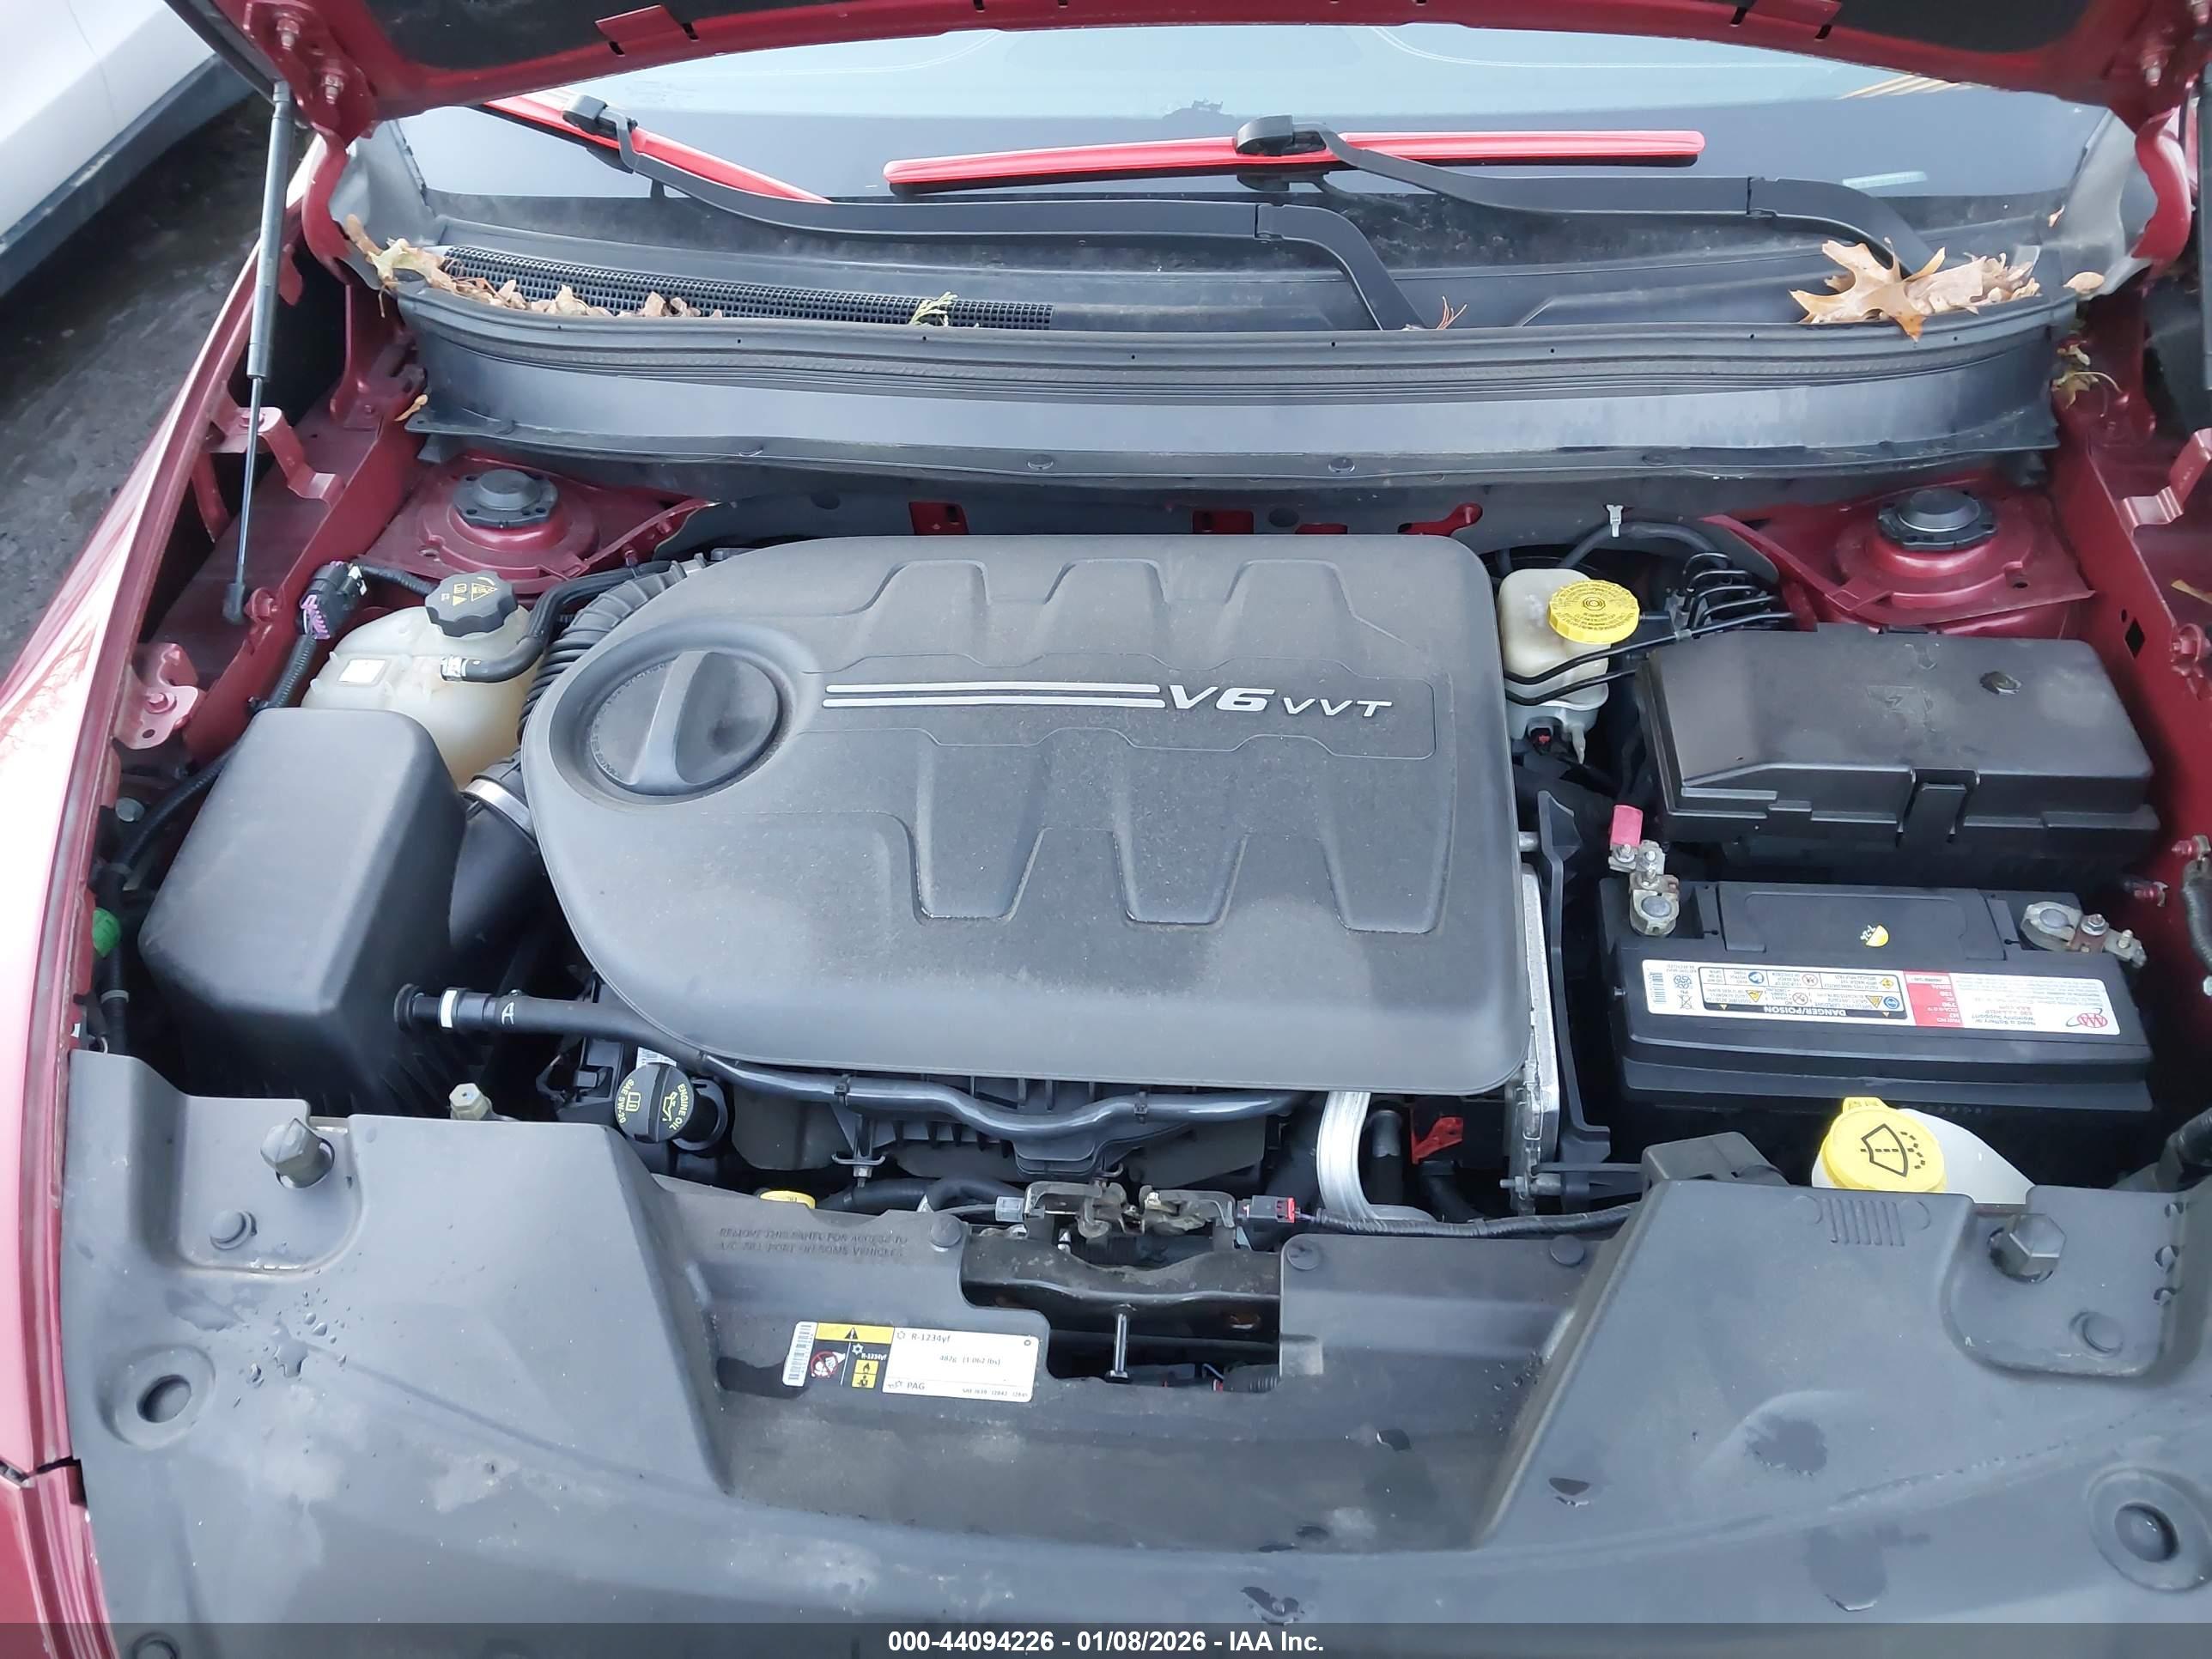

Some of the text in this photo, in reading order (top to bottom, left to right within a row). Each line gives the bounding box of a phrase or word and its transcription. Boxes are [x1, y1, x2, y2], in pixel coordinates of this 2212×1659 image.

[1170, 684, 1393, 717] V6 VVT
[501, 1001, 514, 1024] A
[1763, 1005, 1848, 1017] DANGER/POISON
[617, 1079, 635, 1124] SAE 5W-20
[669, 1083, 689, 1130] ENGINE OIL
[911, 1333, 951, 1344] R-1234yf
[907, 1382, 926, 1390] PAG
